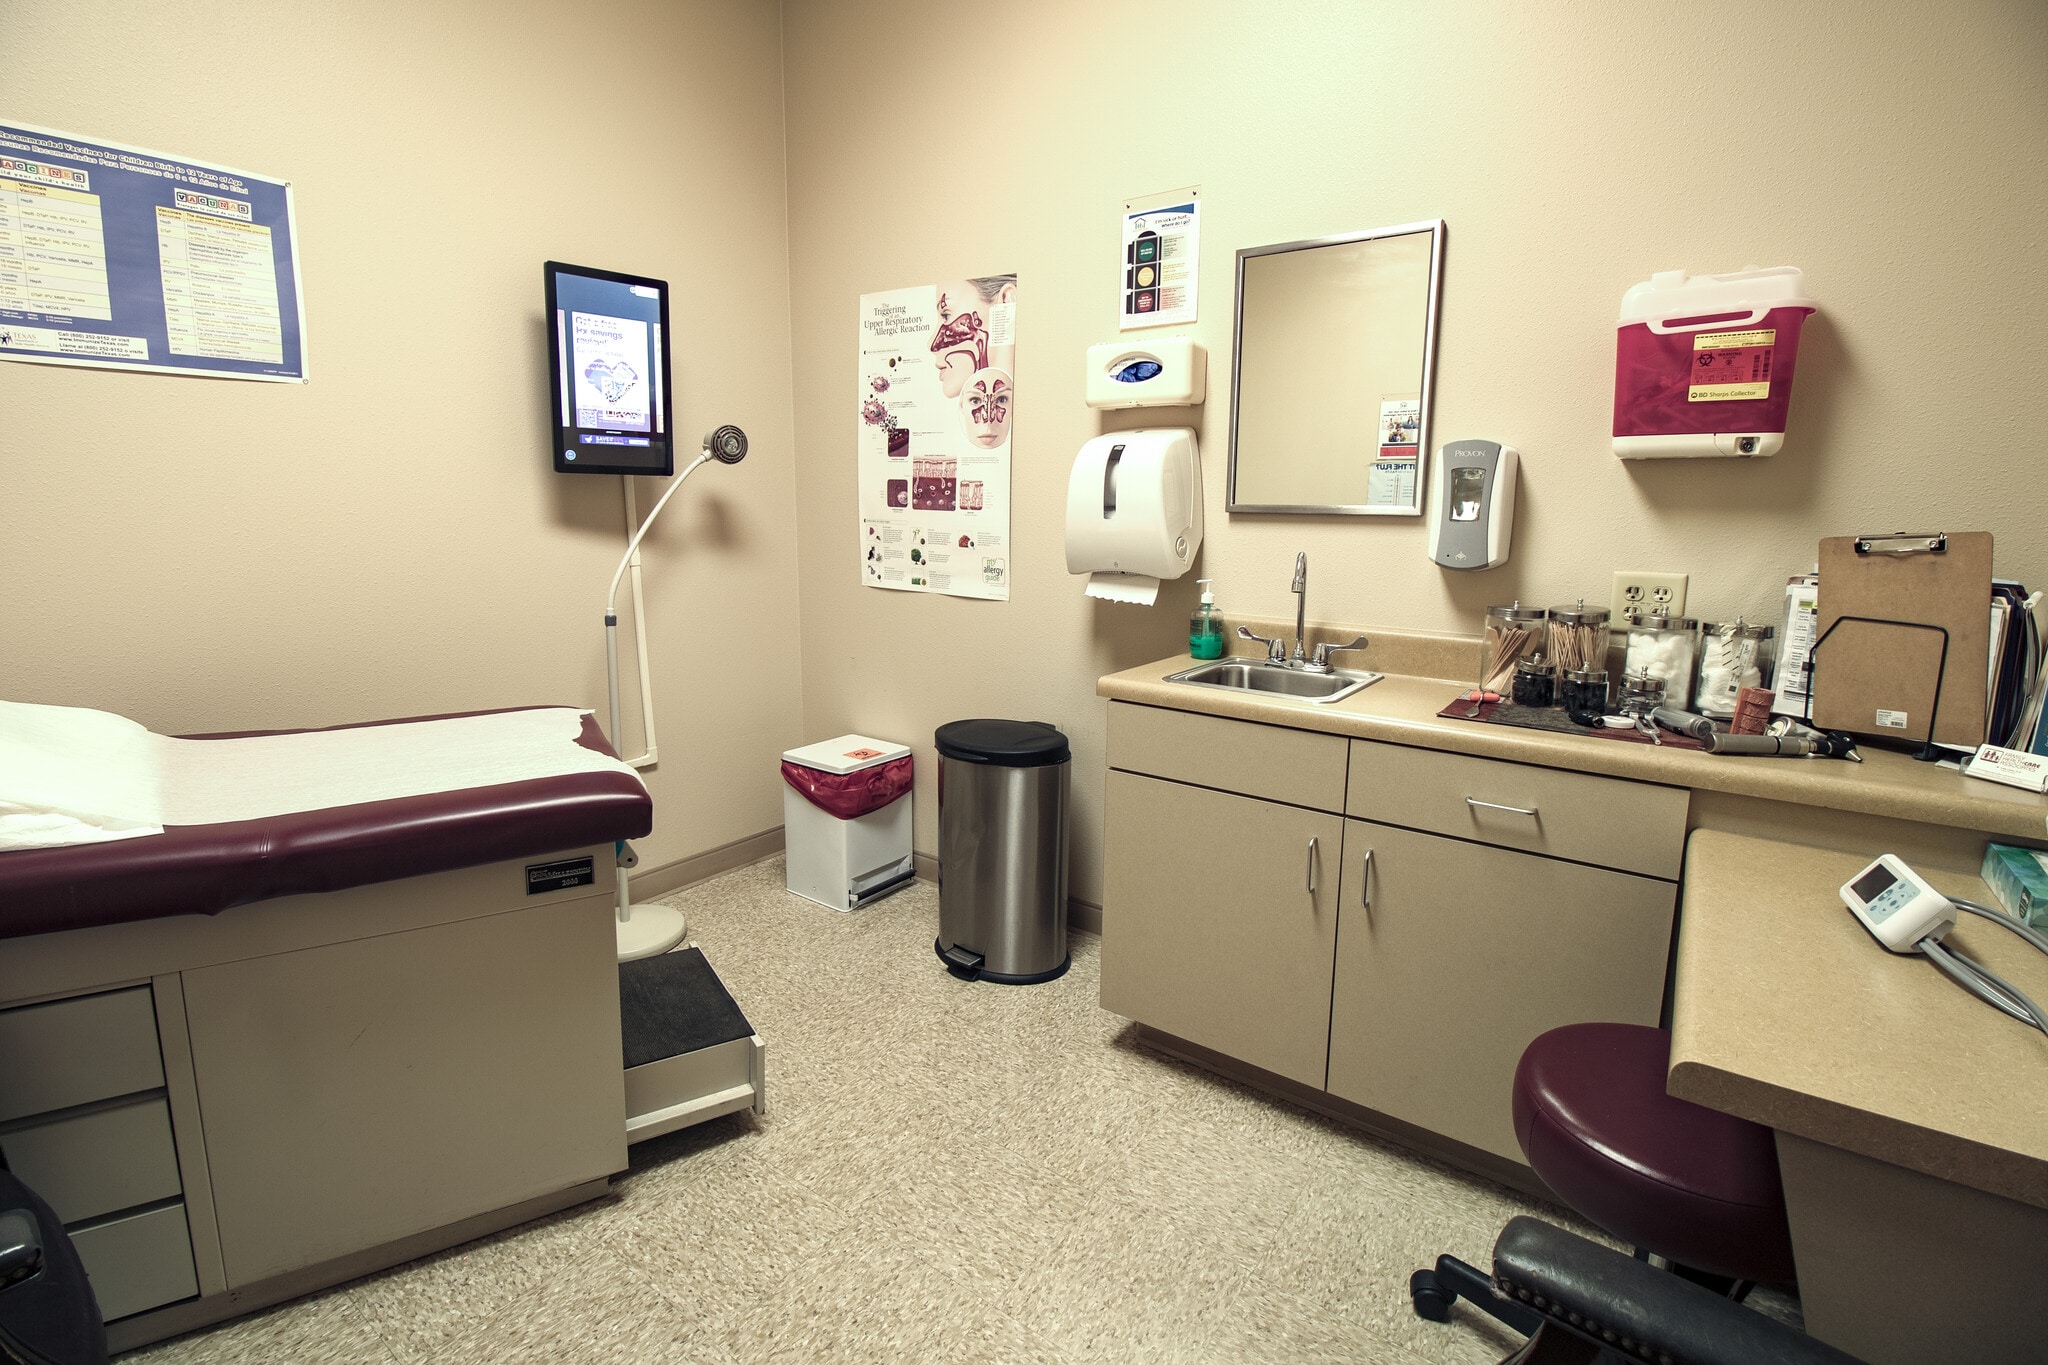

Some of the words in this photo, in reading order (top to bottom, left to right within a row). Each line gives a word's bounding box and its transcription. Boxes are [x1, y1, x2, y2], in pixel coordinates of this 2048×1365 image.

[64, 144, 103, 157] Vaccines
[103, 151, 118, 160] for
[119, 154, 154, 168] Children
[155, 162, 175, 173] Birth
[176, 166, 185, 174] to
[186, 168, 196, 177] 12
[196, 170, 218, 181] Years
[228, 178, 243, 187] Age
[99, 158, 119, 169] Para
[0, 159, 85, 184] ACCINES
[176, 192, 249, 215] VACUNAS
[874, 305, 906, 317] Triggering
[864, 320, 884, 331] Upper
[885, 316, 923, 327] Respiratory
[13, 332, 37, 340] TEXAS
[590, 329, 623, 340] savings
[875, 327, 898, 337] Allergic
[900, 324, 930, 333] Reaction
[1455, 449, 1485, 457] PROVON
[983, 565, 1003, 576] allergy
[2005, 752, 2027, 761] FAMILY
